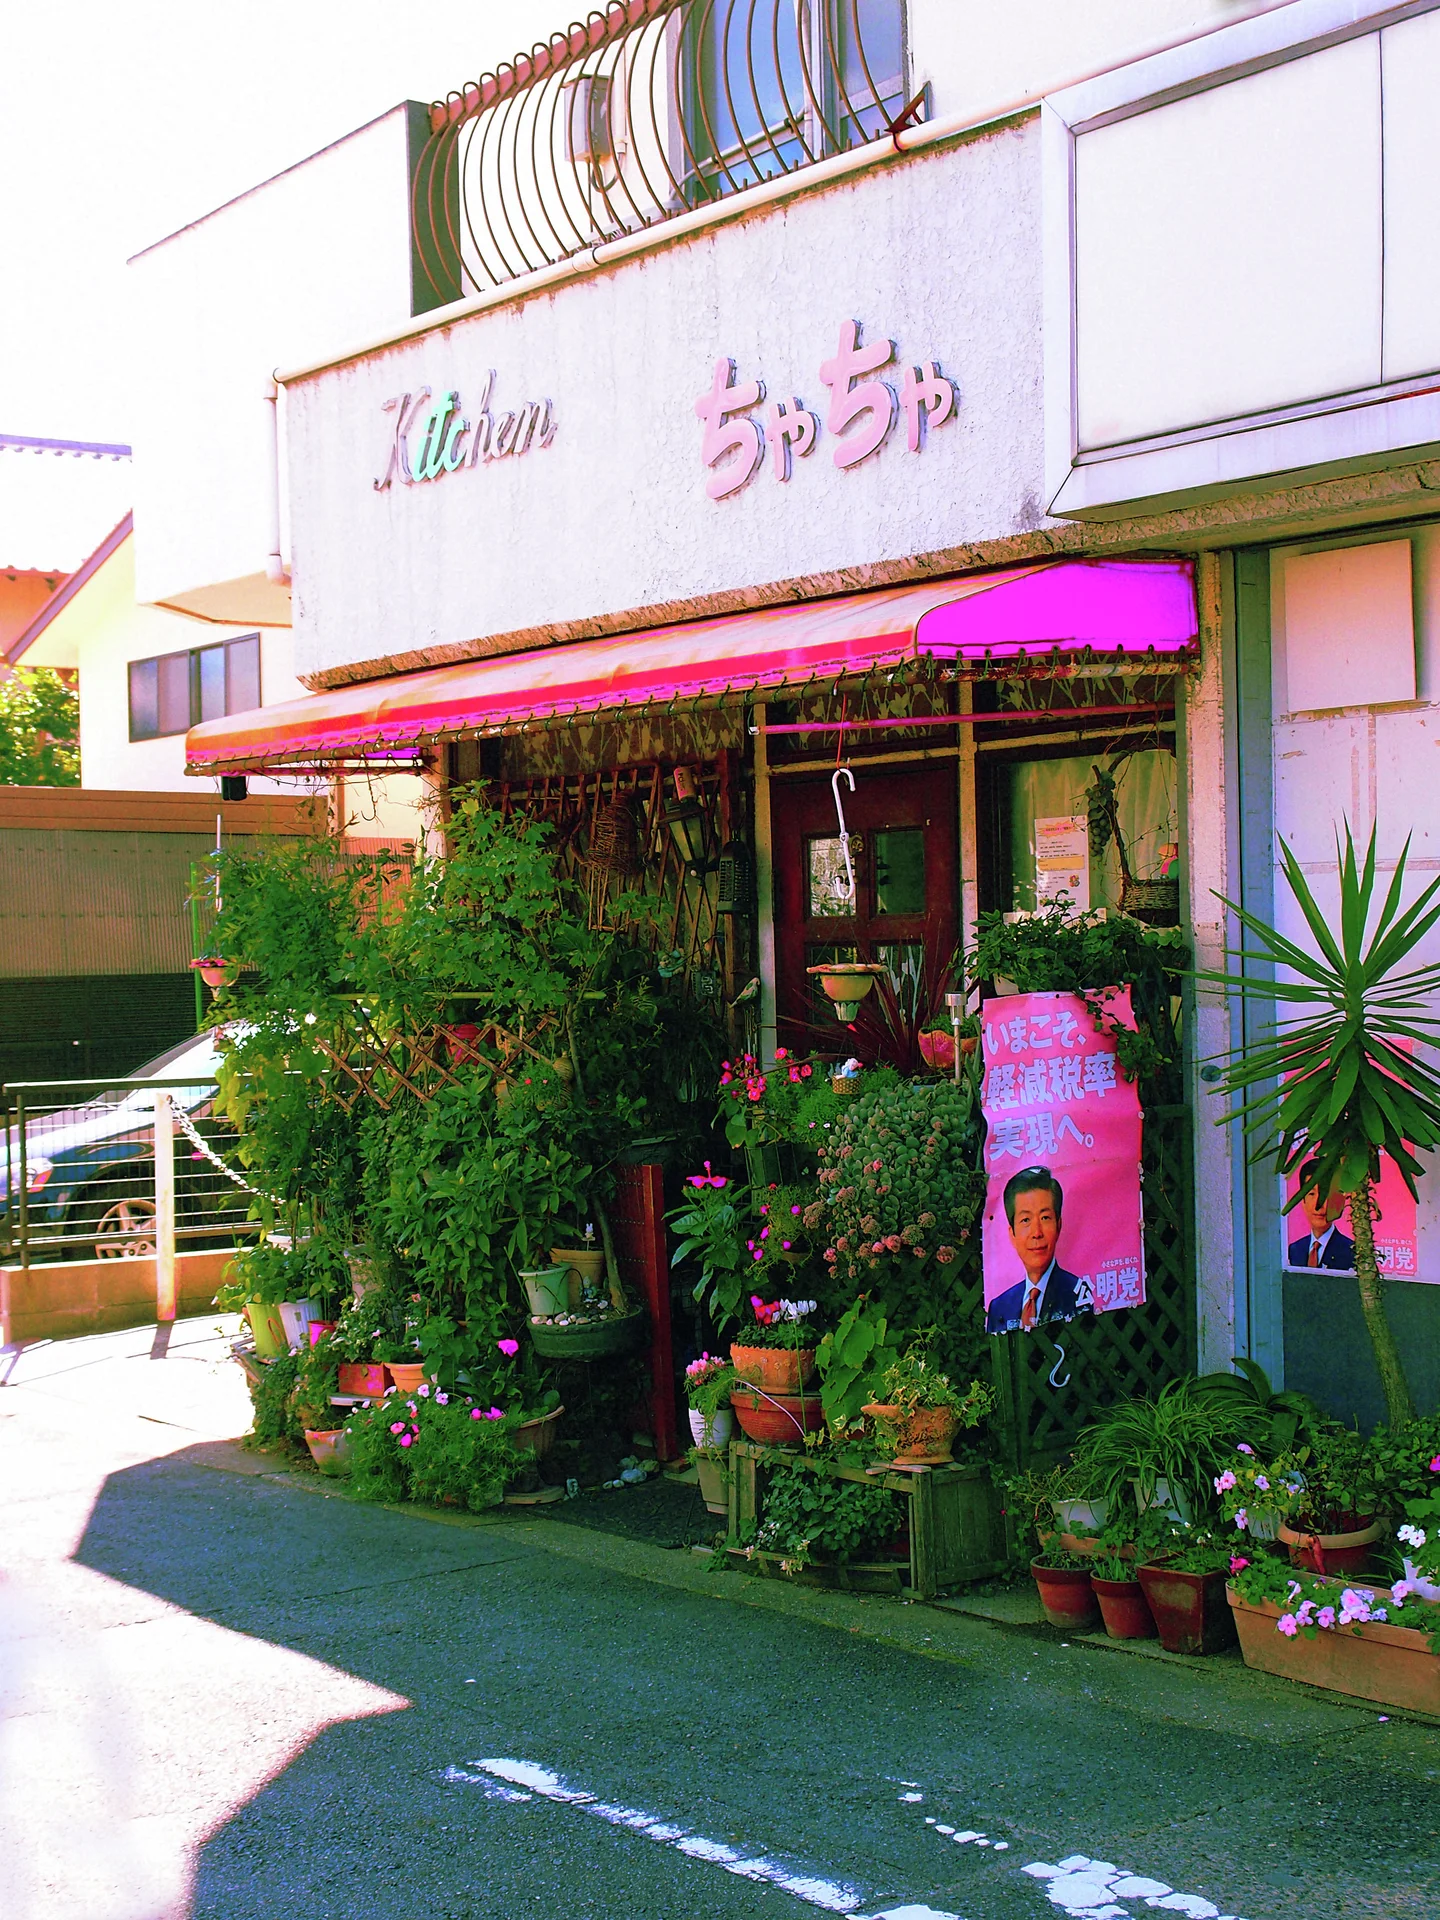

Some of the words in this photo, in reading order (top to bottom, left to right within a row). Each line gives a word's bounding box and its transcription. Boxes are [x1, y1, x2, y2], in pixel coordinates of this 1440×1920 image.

[694, 318, 961, 501] ちゃちゃ
[986, 1011, 1087, 1055] いまこそ、
[986, 1051, 1117, 1112] 軽減税率
[989, 1112, 1094, 1162] 実現へ。
[1375, 1246, 1414, 1270] 明党
[1073, 1266, 1140, 1308] 公明党
